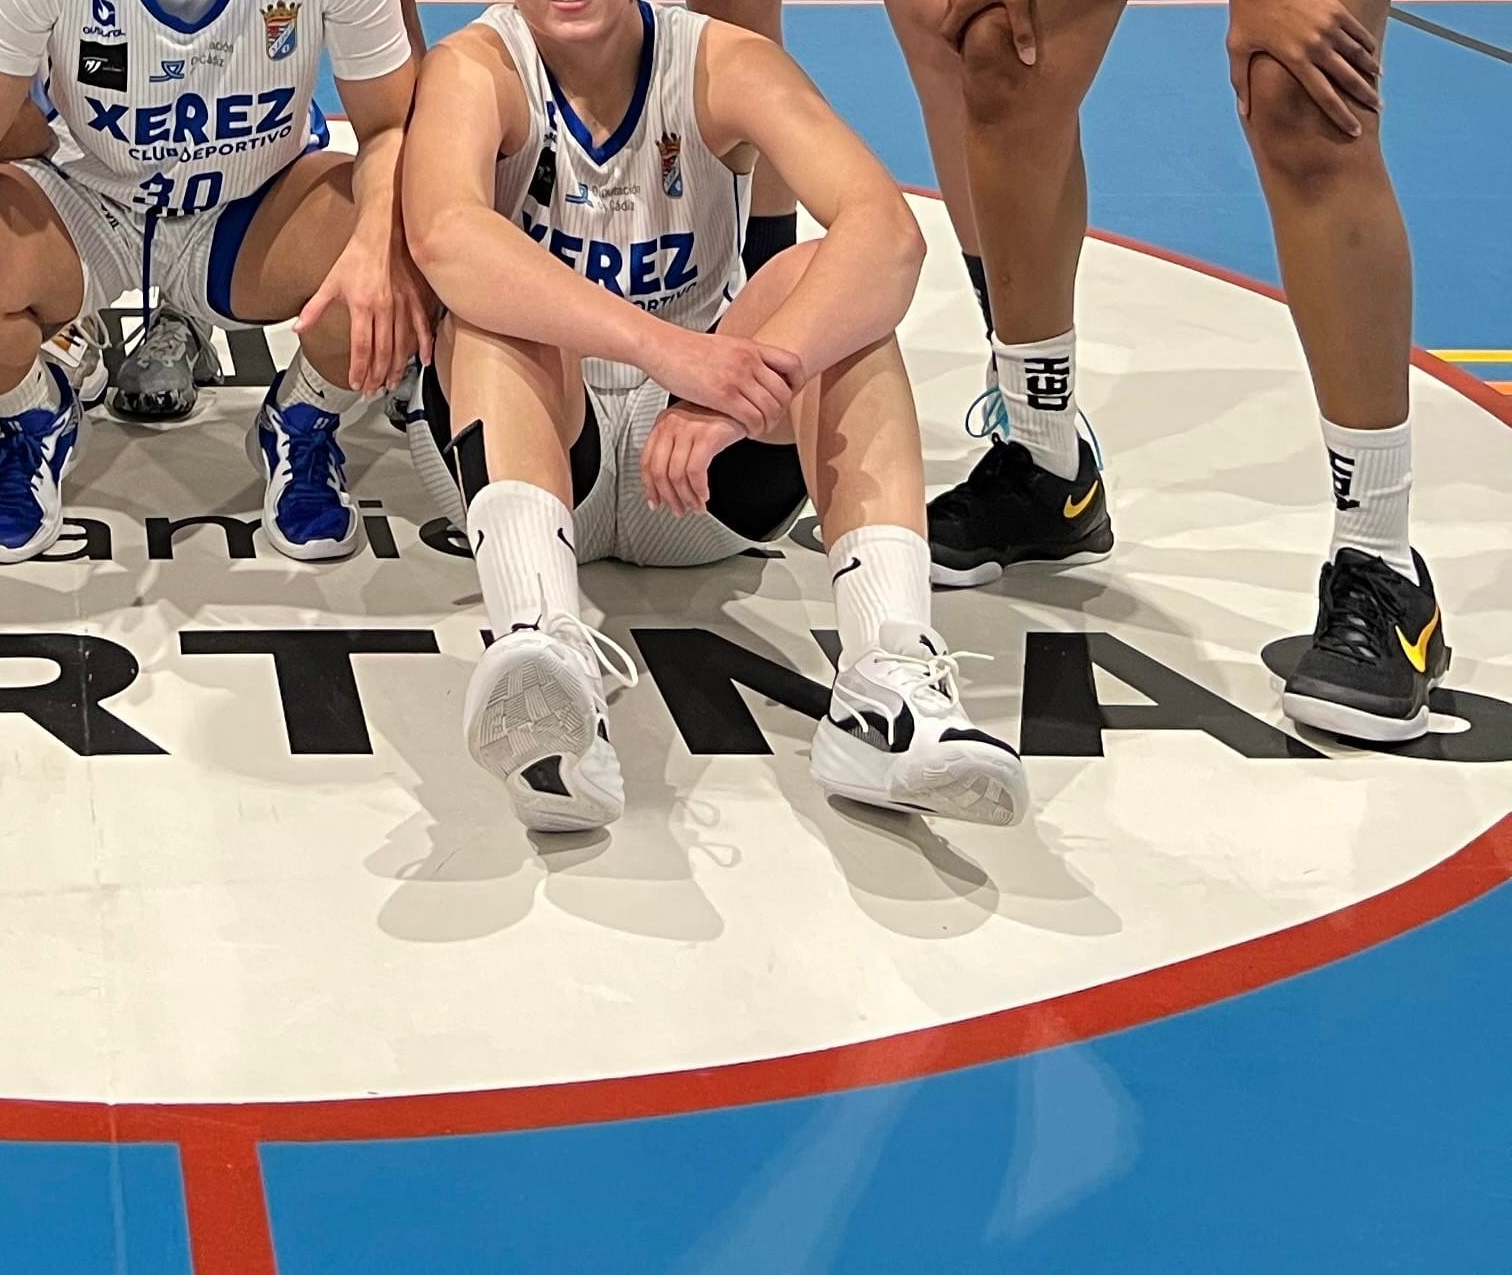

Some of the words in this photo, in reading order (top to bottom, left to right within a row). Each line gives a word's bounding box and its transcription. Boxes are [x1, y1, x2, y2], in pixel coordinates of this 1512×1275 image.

[84, 86, 296, 148] XEREZ
[128, 146, 178, 163] CLUB
[179, 125, 292, 163] DEPORTIVO
[133, 170, 224, 213] 30
[522, 210, 698, 297] XEREZ
[634, 282, 697, 312] ORTIVO
